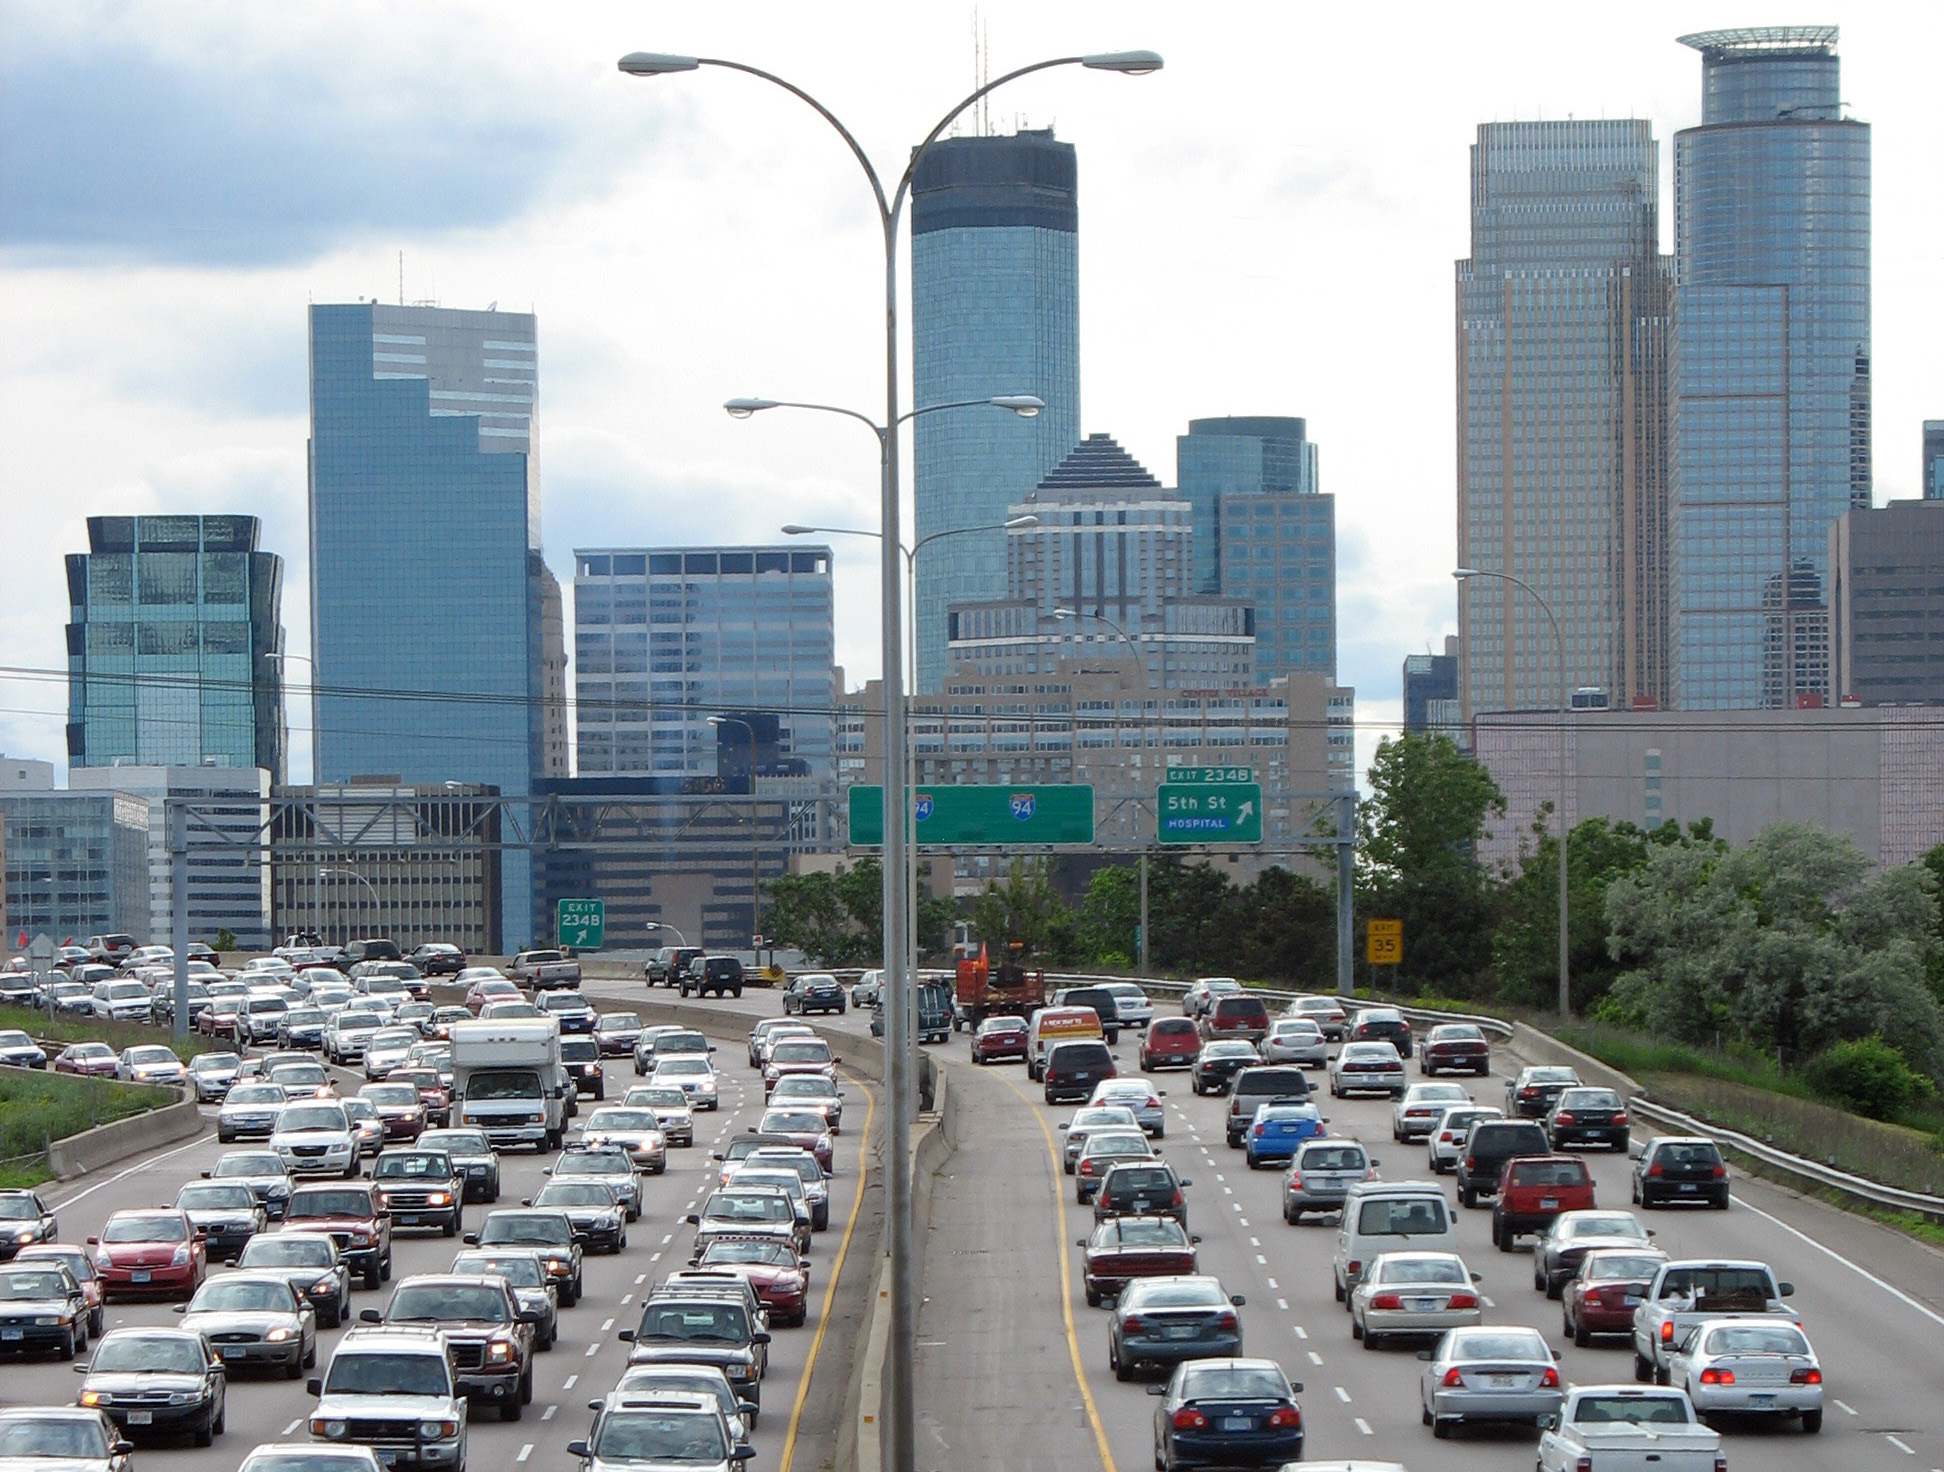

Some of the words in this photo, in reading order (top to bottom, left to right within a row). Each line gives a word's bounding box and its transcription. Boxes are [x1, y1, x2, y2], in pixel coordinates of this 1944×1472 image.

[1170, 770, 1197, 780] EXIT
[1204, 769, 1249, 782] 234B
[1012, 802, 1031, 814] 94
[1168, 796, 1198, 810] 5th
[1208, 796, 1226, 810] St
[1168, 818, 1226, 828] HOSPITAL
[568, 904, 596, 912] EXIT
[562, 914, 600, 926] 234B
[1374, 940, 1394, 952] 35
